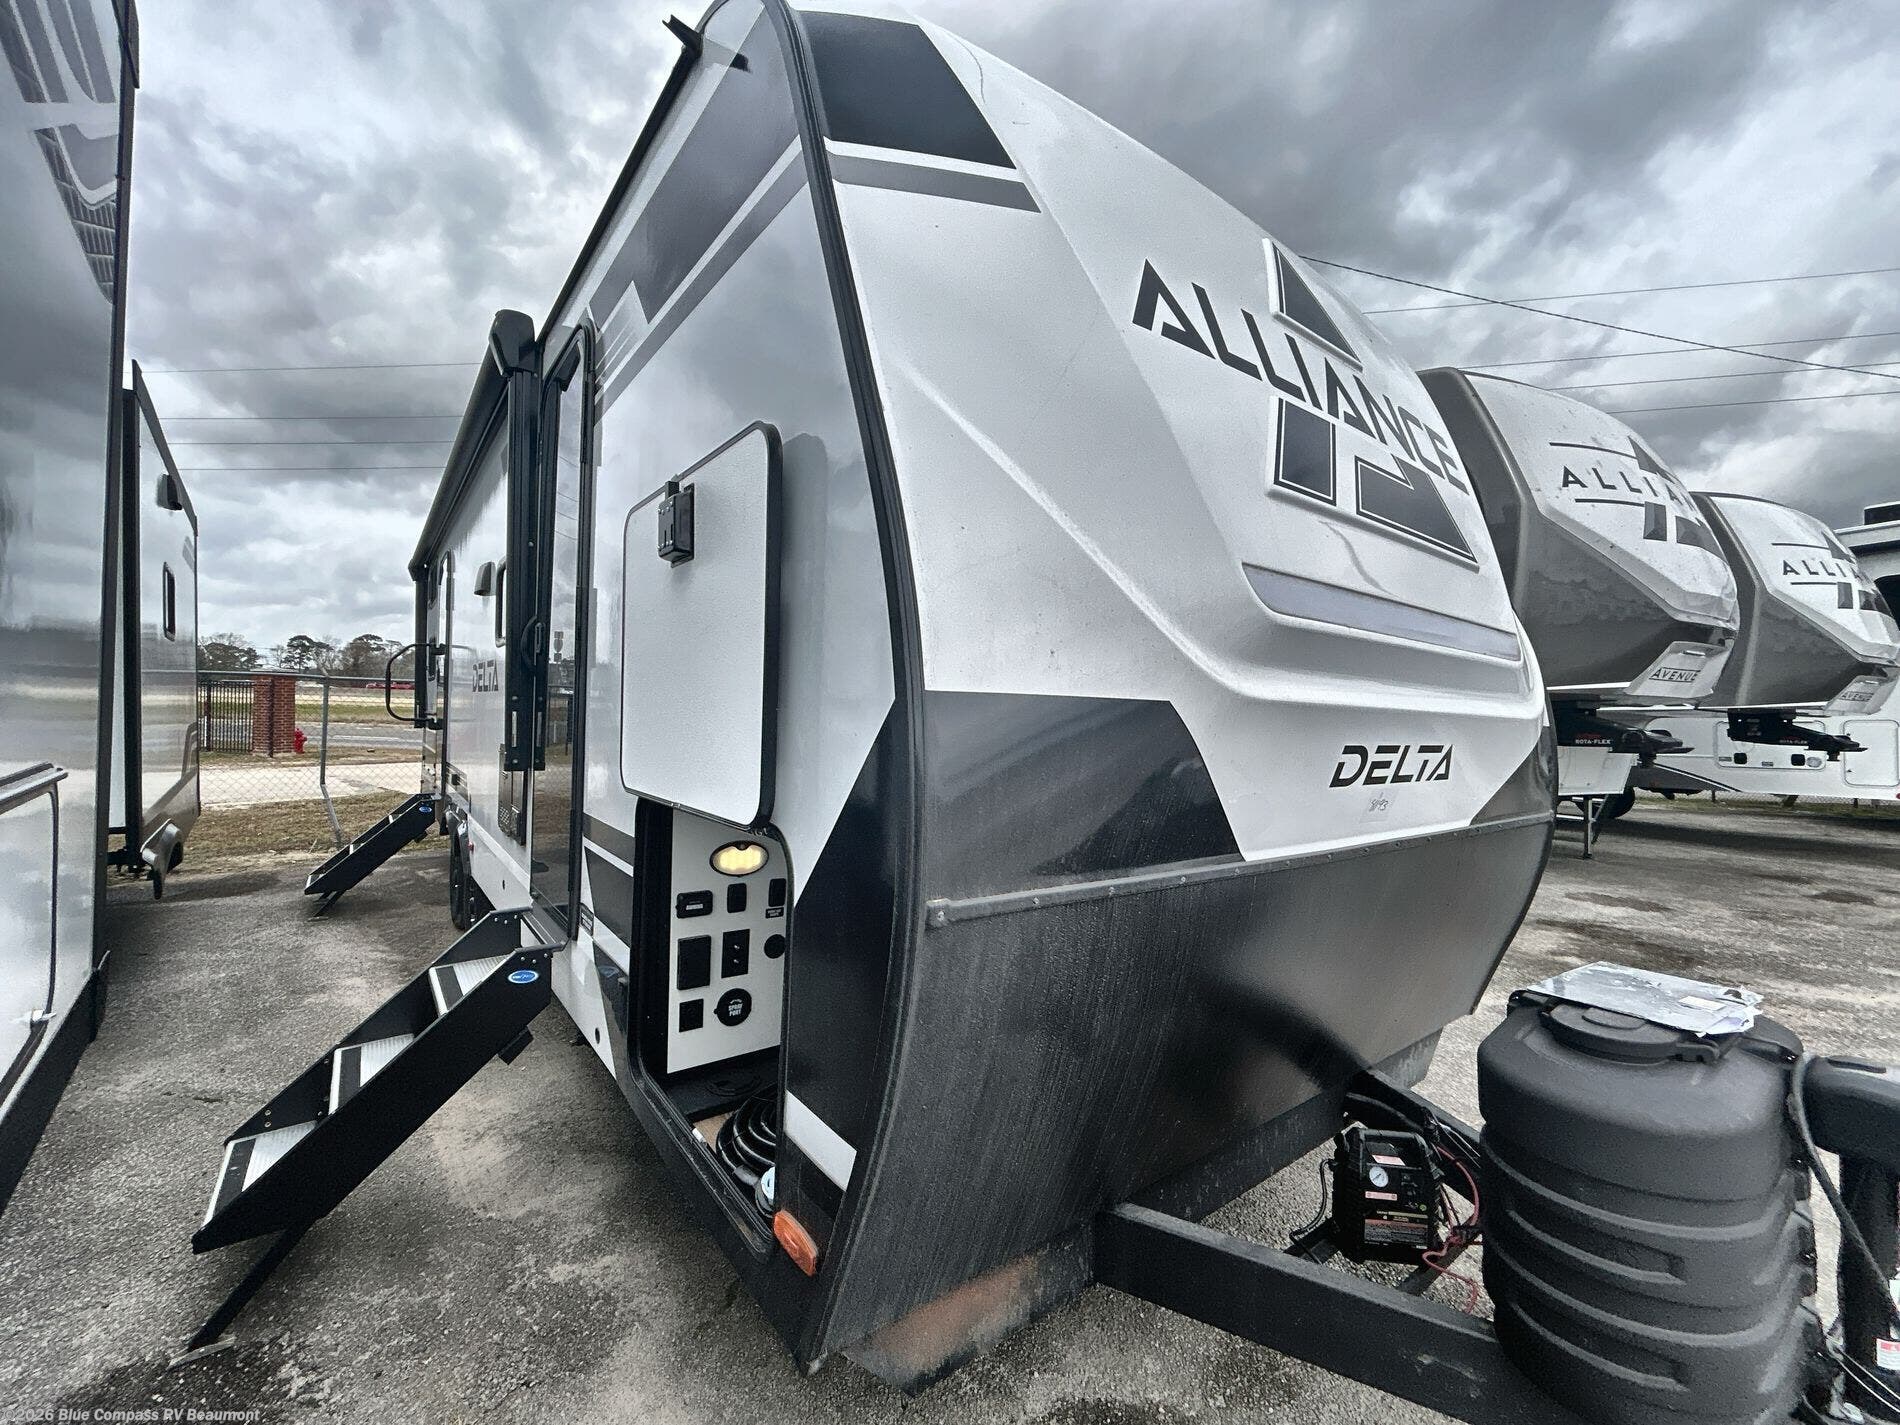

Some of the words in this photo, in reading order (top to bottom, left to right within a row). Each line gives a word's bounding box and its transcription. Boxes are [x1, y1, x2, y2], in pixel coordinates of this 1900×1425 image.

[1131, 257, 1470, 497] ALLIANCE
[472, 659, 499, 692] DELTA
[1651, 667, 1698, 681] AVENUE
[1328, 744, 1453, 788] DELTA
